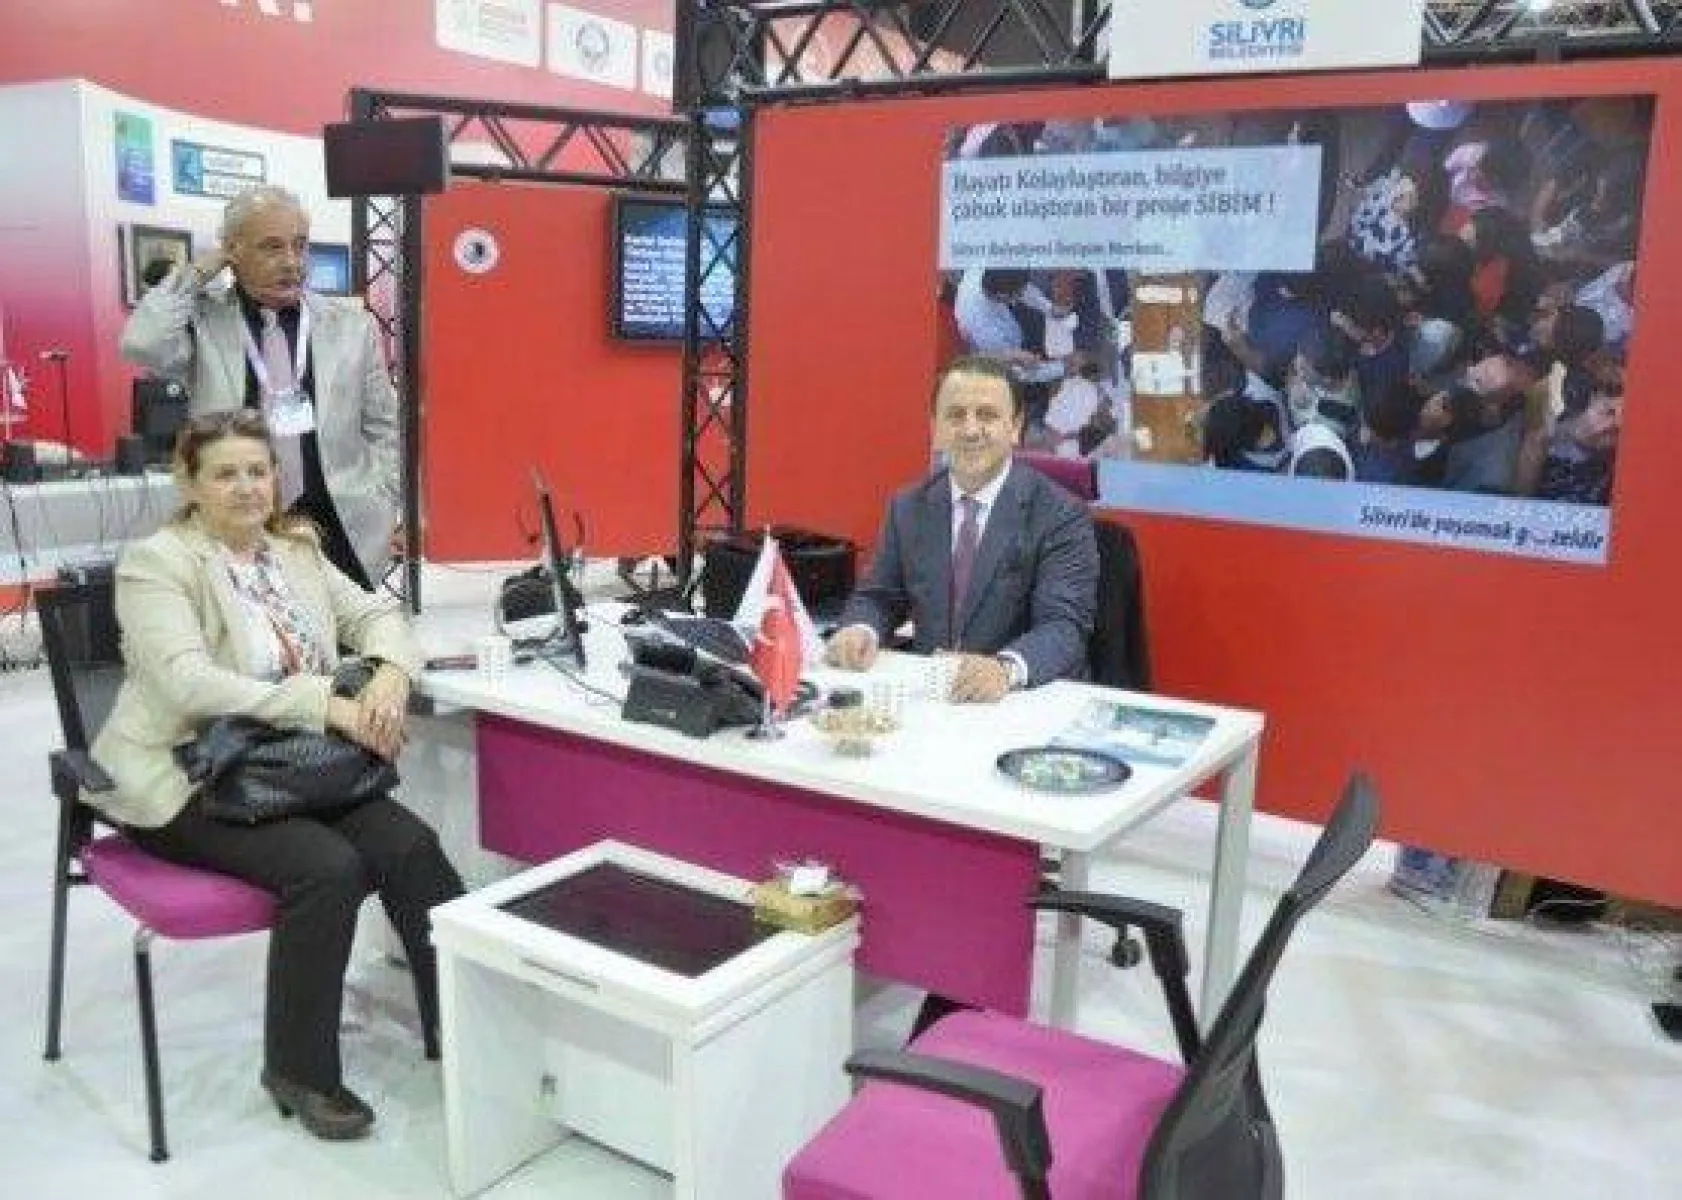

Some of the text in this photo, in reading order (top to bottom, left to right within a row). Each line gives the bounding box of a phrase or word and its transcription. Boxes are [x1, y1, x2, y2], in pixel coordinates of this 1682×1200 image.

[1155, 163, 1227, 190] bilgiye
[1102, 197, 1131, 217] bir
[1136, 195, 1191, 219] proje
